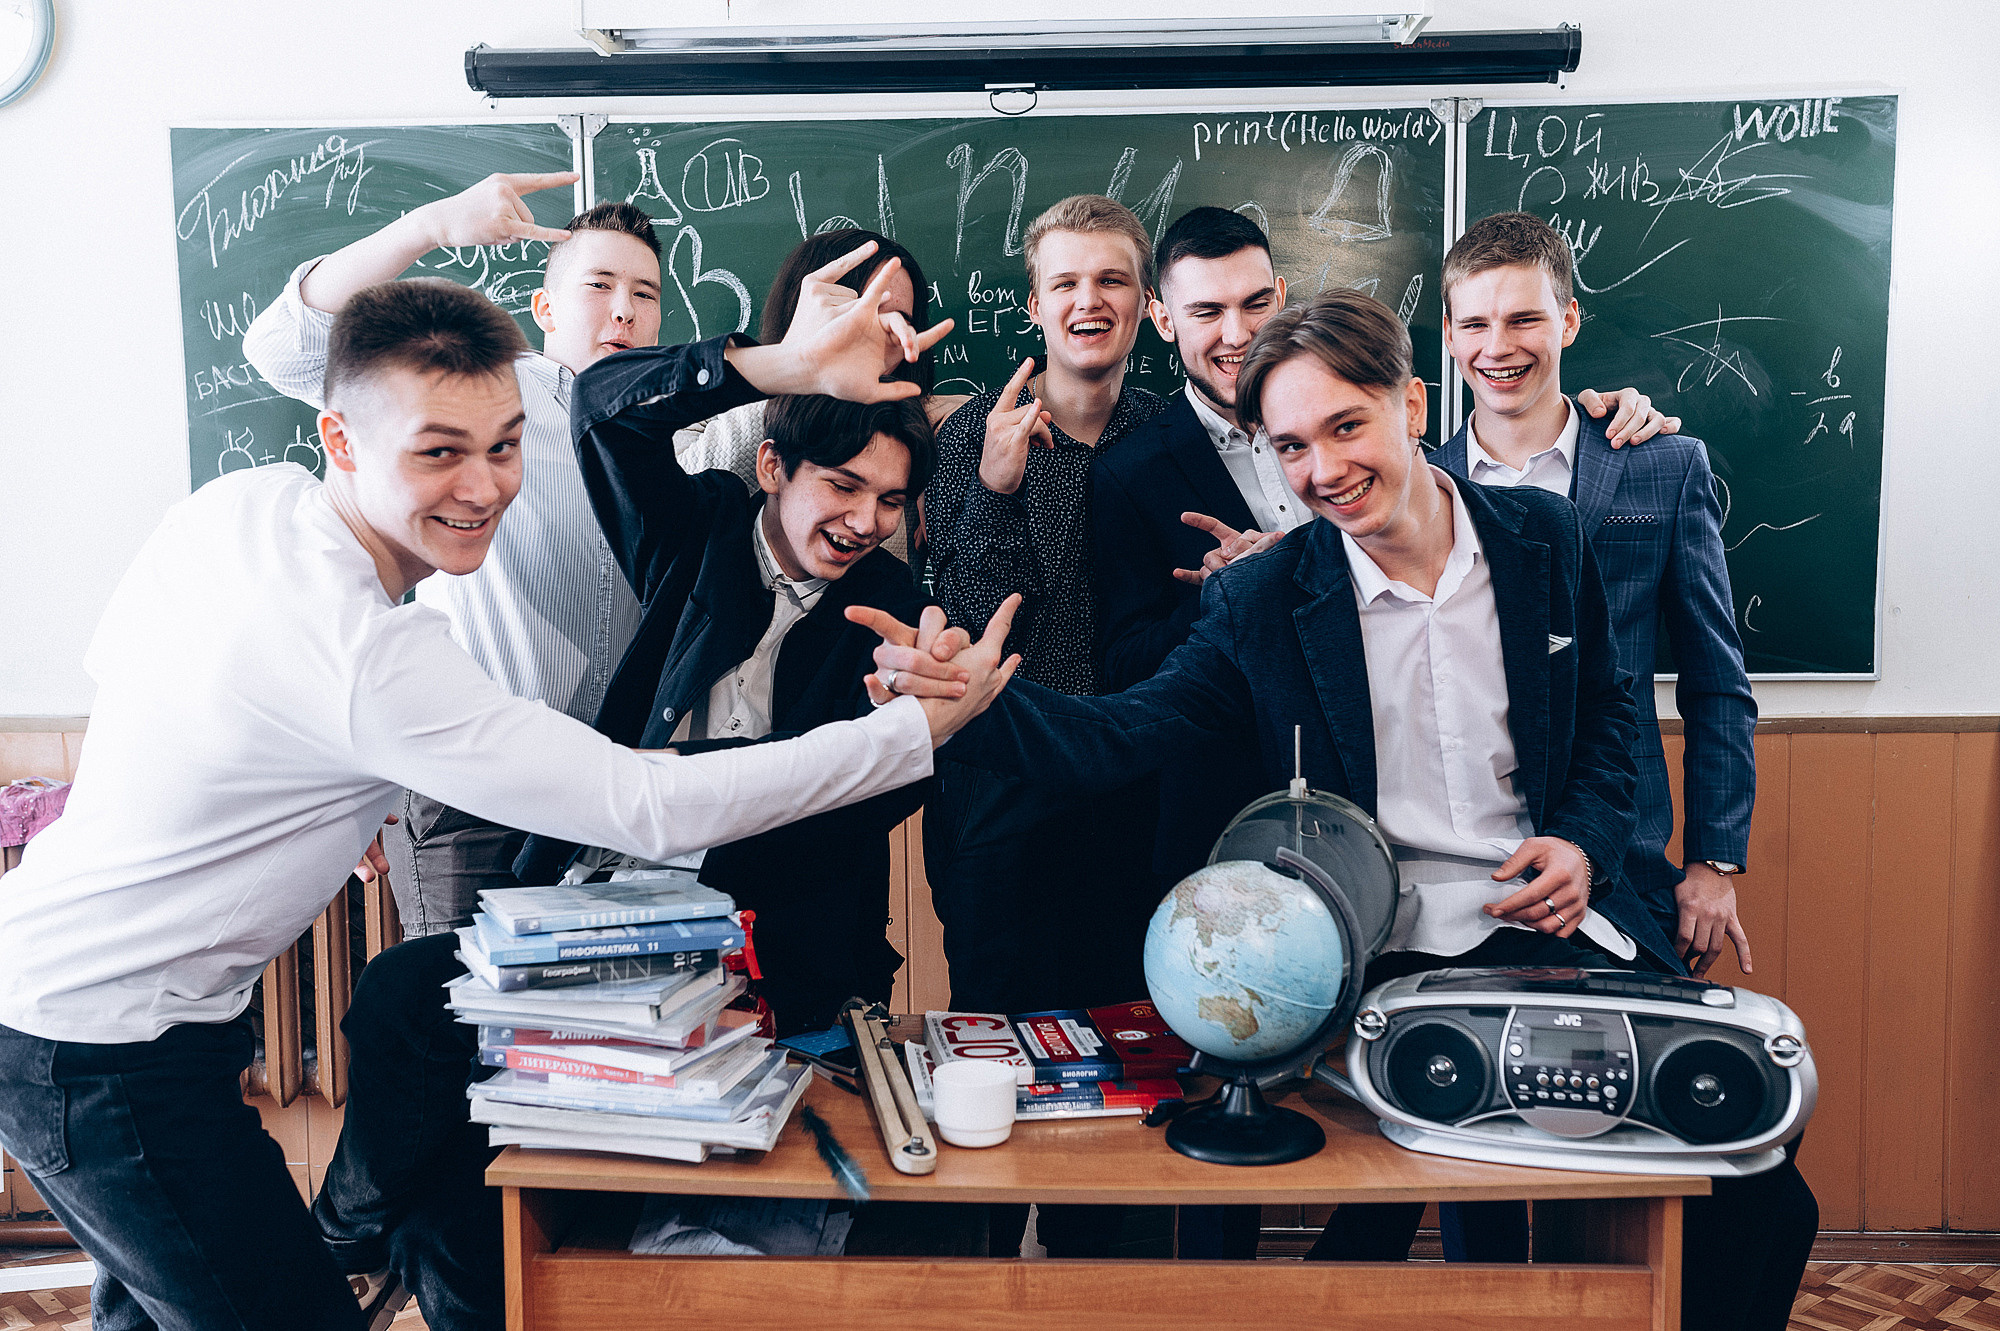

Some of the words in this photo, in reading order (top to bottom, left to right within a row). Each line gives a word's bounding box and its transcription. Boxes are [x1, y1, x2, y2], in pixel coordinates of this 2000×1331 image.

[194, 360, 268, 400] БАСТ
[559, 942, 640, 959] ИНФОРМАТИКА
[647, 941, 659, 952] 11
[542, 964, 591, 979] География
[1553, 1013, 1582, 1027] JVC
[518, 1055, 598, 1076] ЛИТЕРАТУРА
[1062, 1070, 1098, 1079] БИОЛОГИЯ
